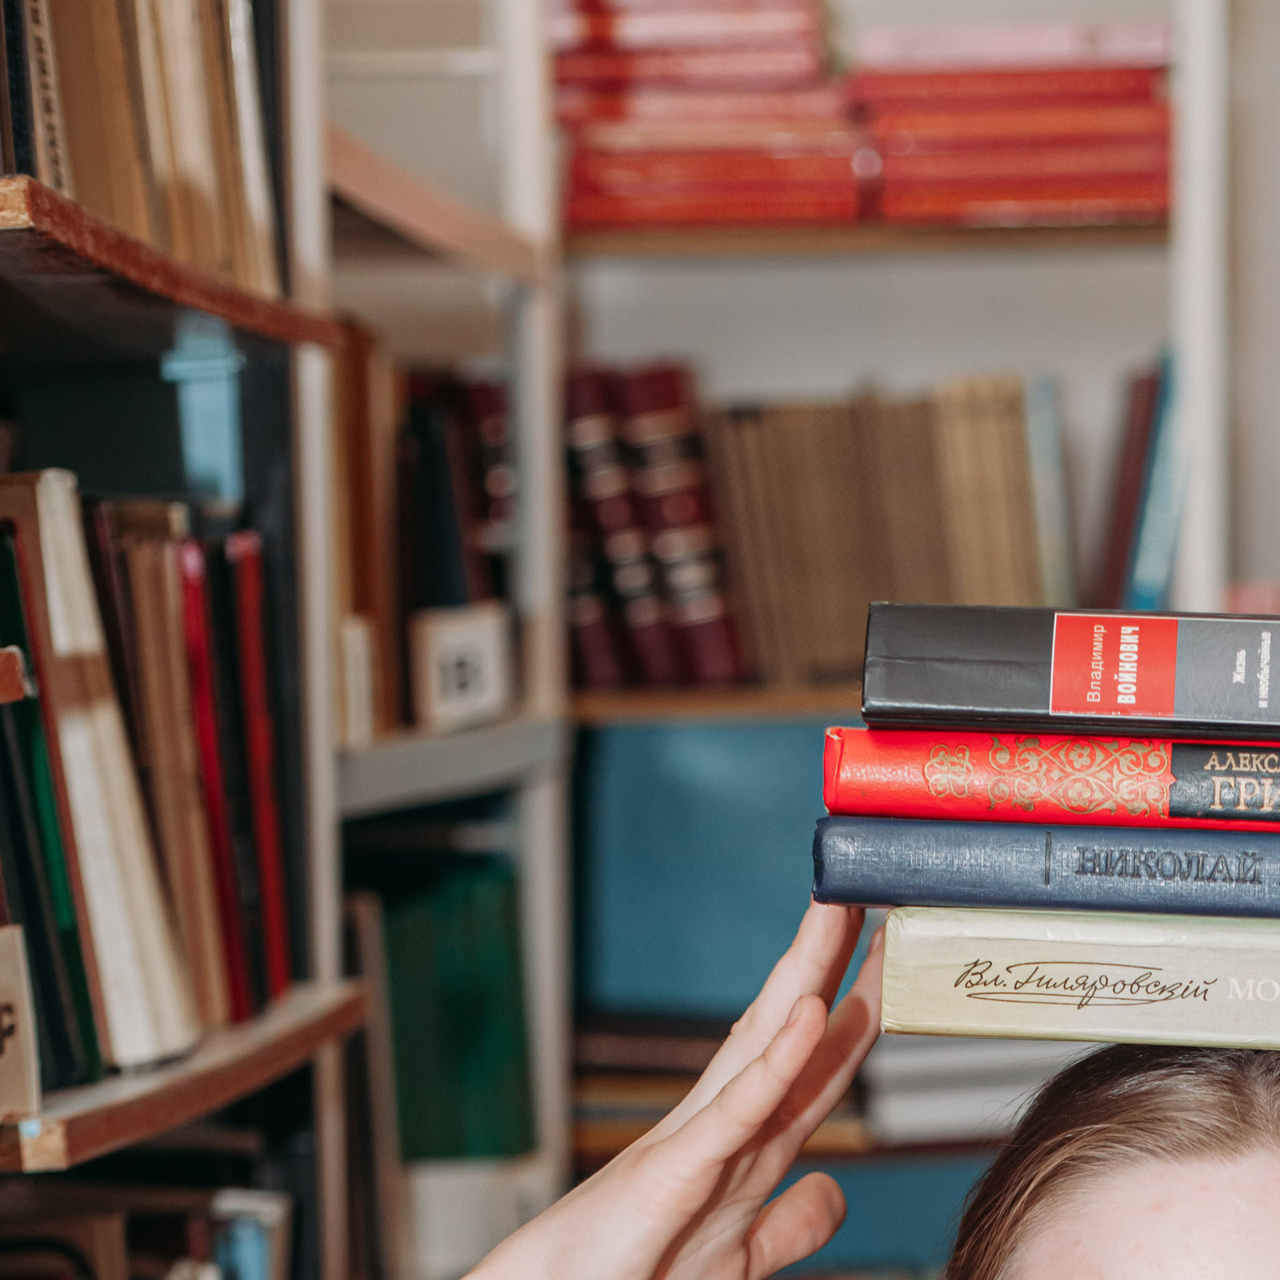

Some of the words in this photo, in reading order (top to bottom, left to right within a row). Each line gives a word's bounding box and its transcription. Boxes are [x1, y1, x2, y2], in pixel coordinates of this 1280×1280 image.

[1086, 623, 1108, 703] Владимир
[1113, 625, 1140, 705] ВОЙНОВИЧ
[1232, 648, 1247, 684] Жизнь
[1257, 631, 1271, 699] необычайные
[1074, 846, 1264, 885] НИКОЛАЙ
